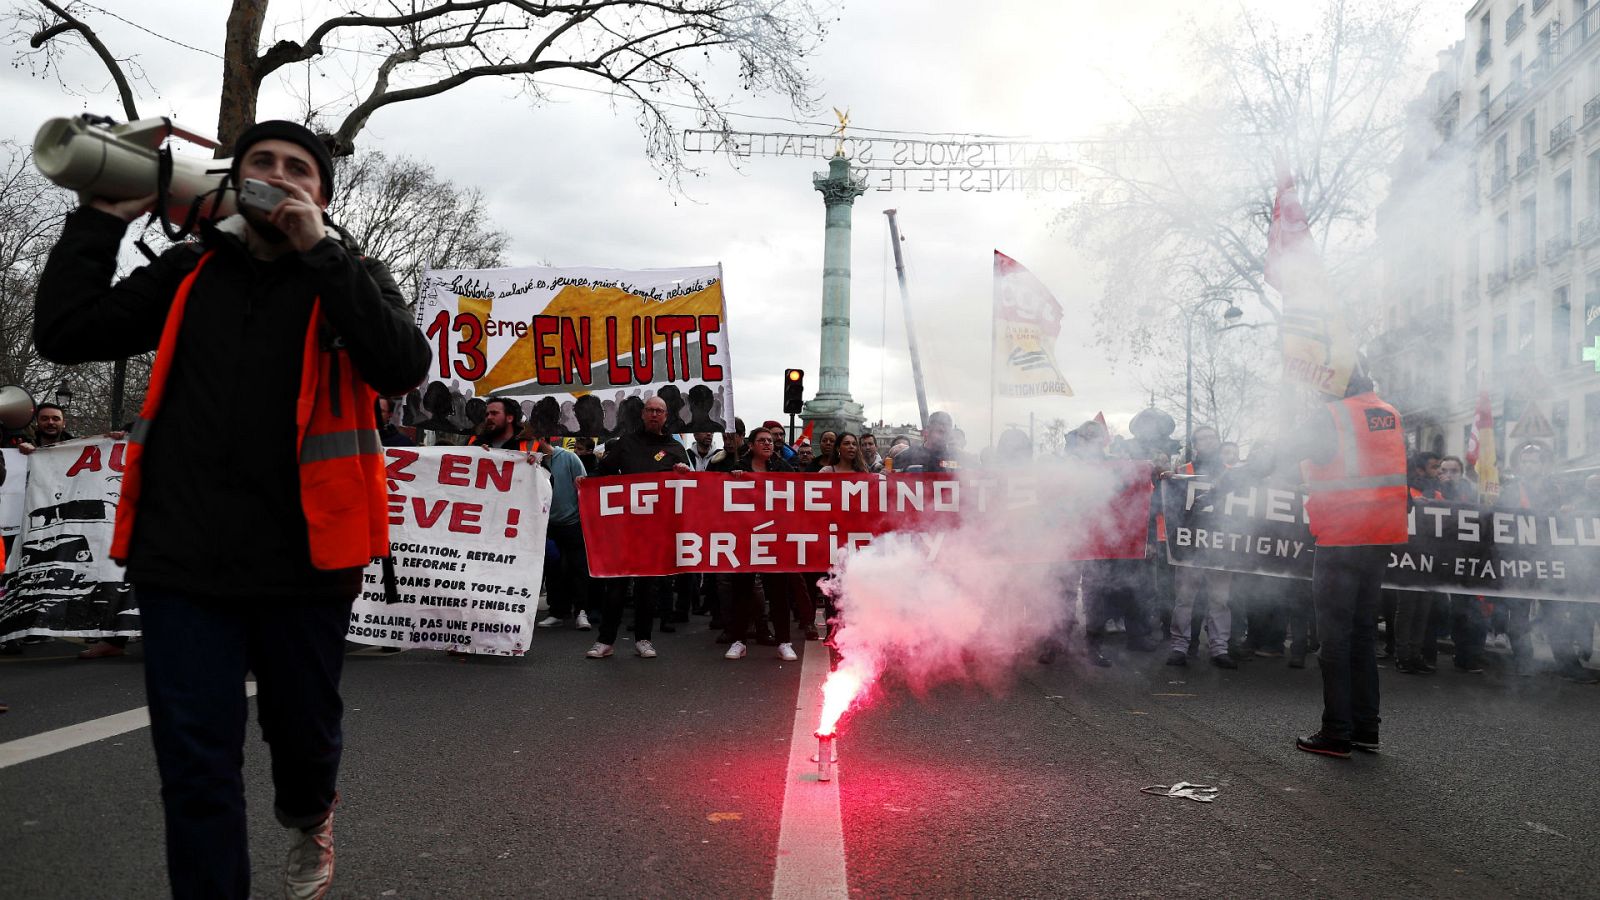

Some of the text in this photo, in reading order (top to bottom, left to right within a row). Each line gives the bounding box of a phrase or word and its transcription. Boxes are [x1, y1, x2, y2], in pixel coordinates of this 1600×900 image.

[532, 314, 592, 385] EN
[606, 314, 724, 385] LUTTE
[1370, 415, 1395, 427] SNCF
[438, 454, 514, 492] EN
[387, 480, 483, 535] ÈVE
[599, 479, 698, 516] CGT
[1493, 511, 1537, 545] EN
[390, 542, 517, 565] GOCIATION, RETRAIT
[402, 558, 458, 572] REFORME
[1454, 557, 1566, 579] ETAMPES
[434, 578, 466, 591] POUR
[362, 591, 386, 602] POU
[420, 595, 468, 608] METIERS
[471, 599, 526, 614] PENIBLES
[348, 625, 387, 639] SSOUS
[390, 630, 404, 641] DE
[420, 617, 442, 629] PAS
[446, 620, 468, 631] UNE
[471, 621, 521, 634] PENSION
